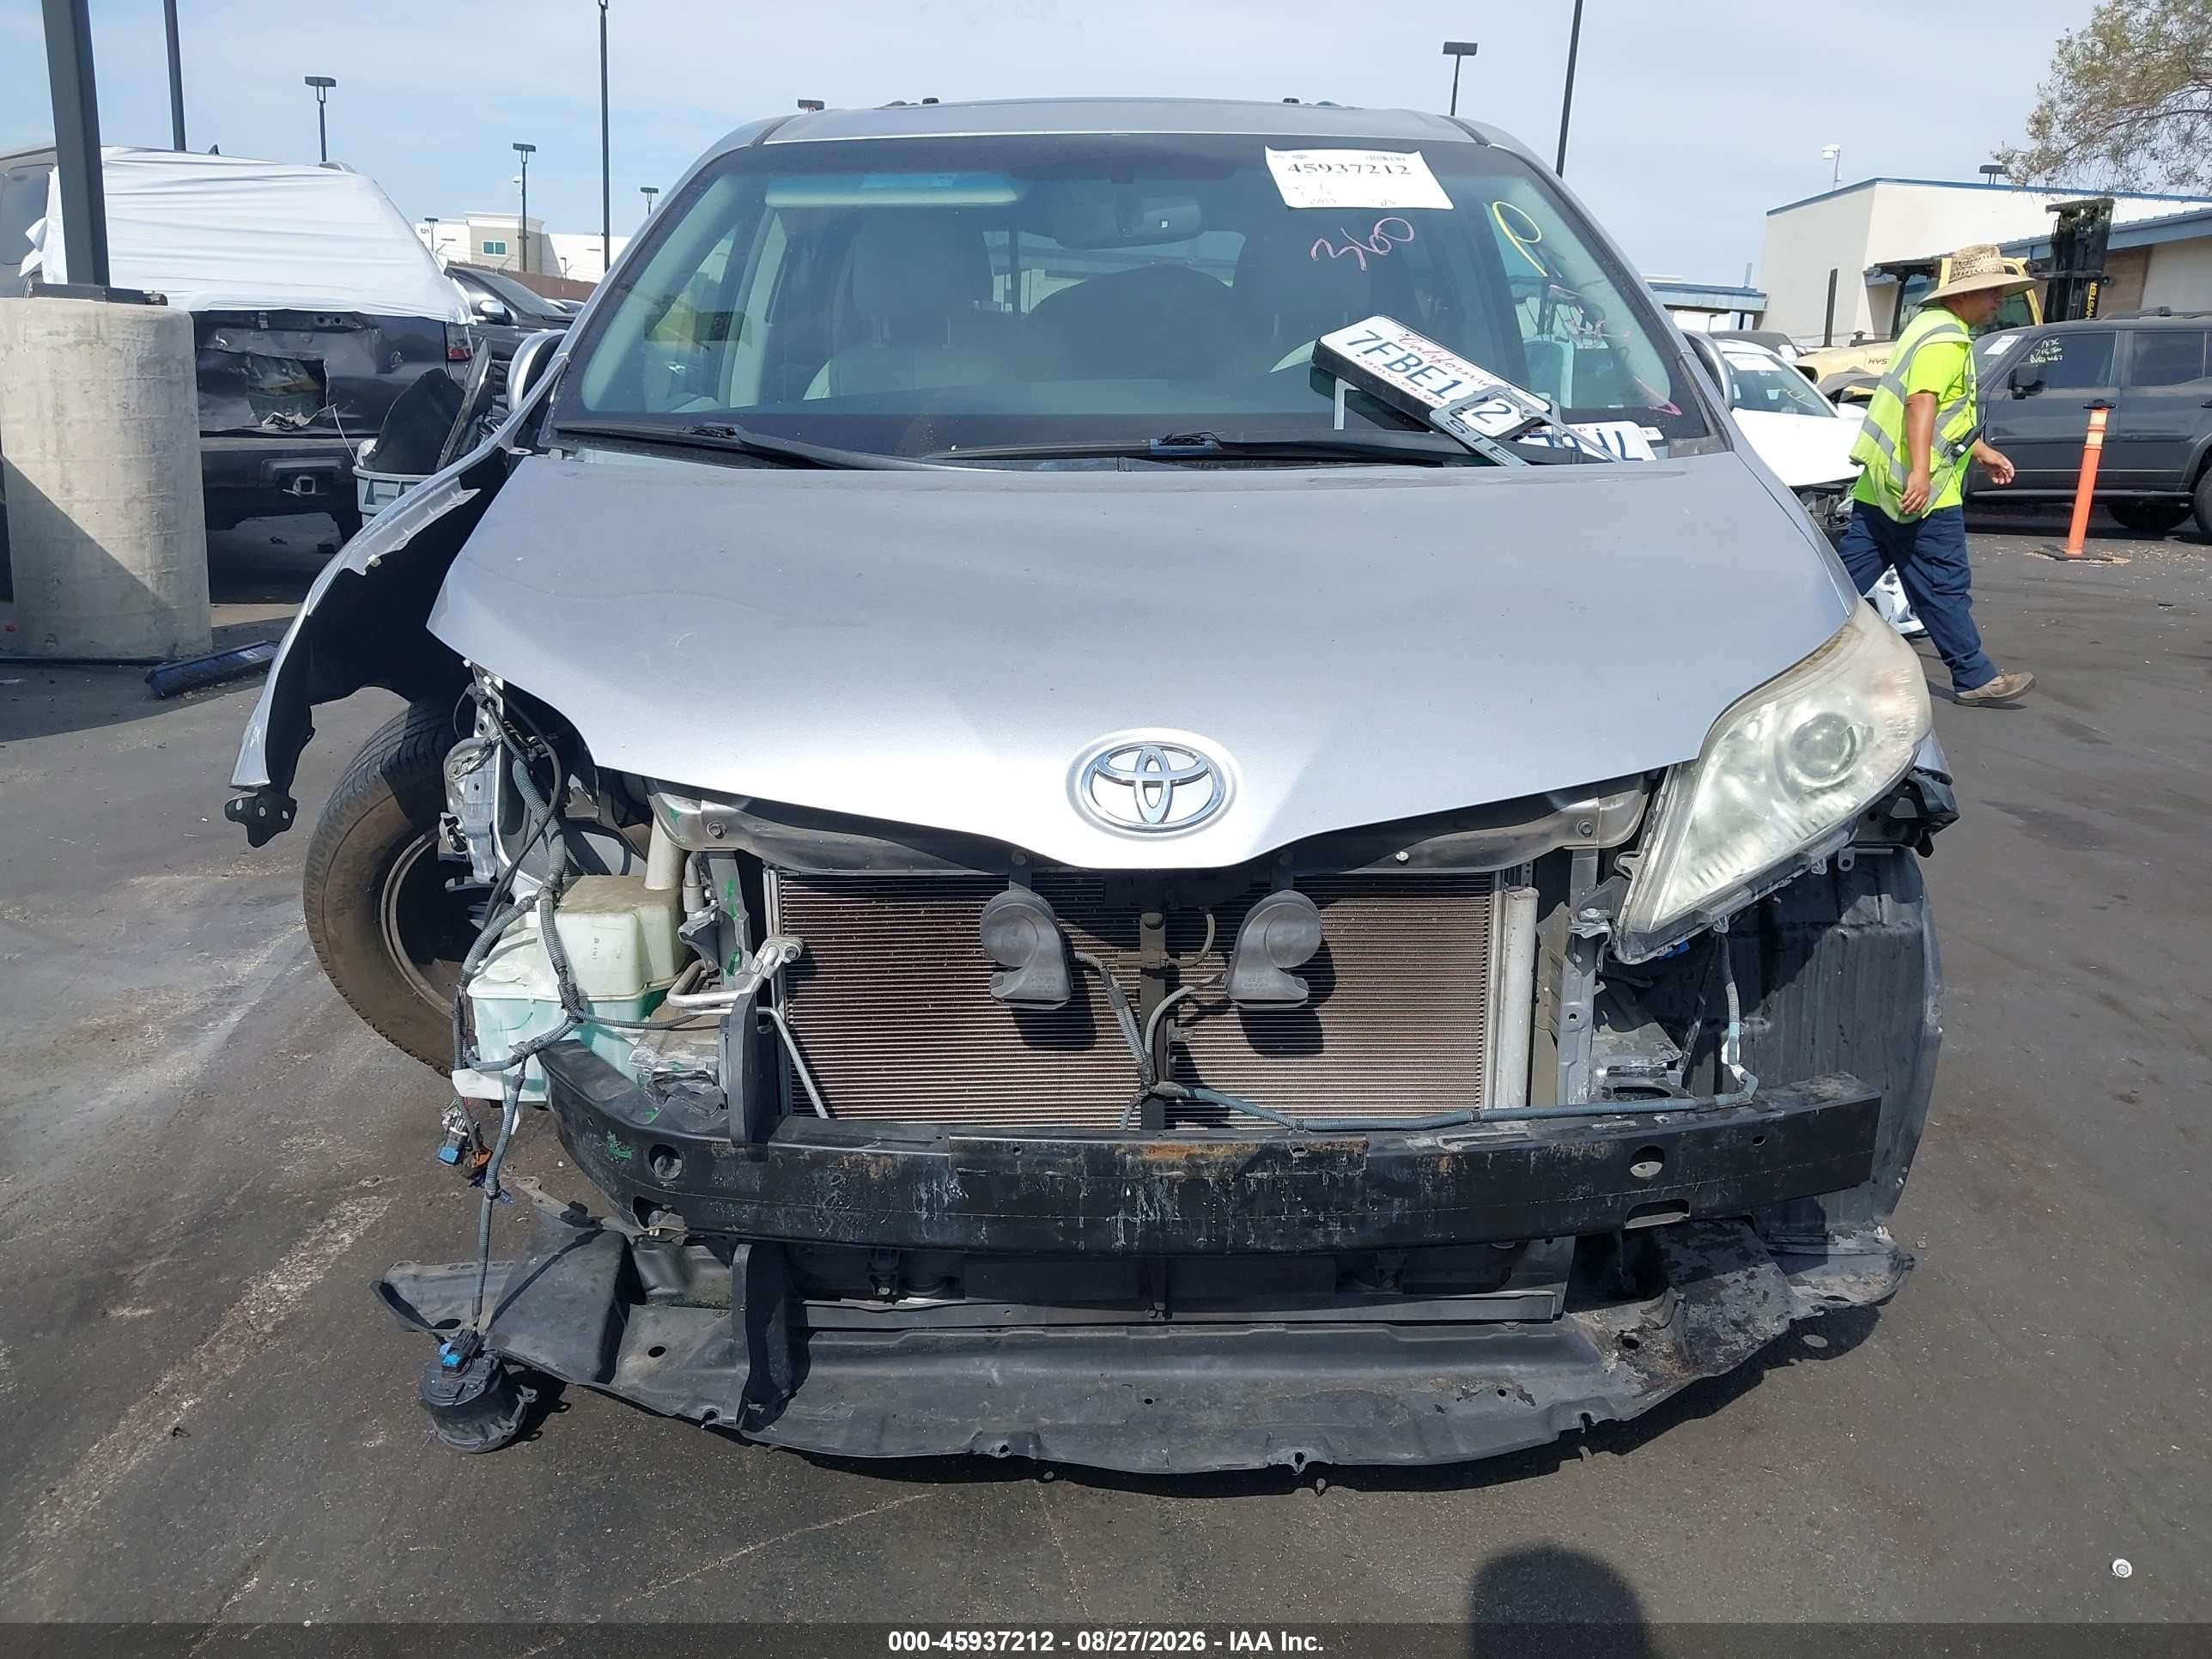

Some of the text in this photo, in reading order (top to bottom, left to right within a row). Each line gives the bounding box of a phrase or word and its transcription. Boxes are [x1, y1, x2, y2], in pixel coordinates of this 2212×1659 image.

[1286, 162, 1413, 176] 45937212
[1346, 329, 1512, 424] 7FBE12
[1398, 330, 1492, 383] Californi
[1445, 419, 1527, 466] SIE
